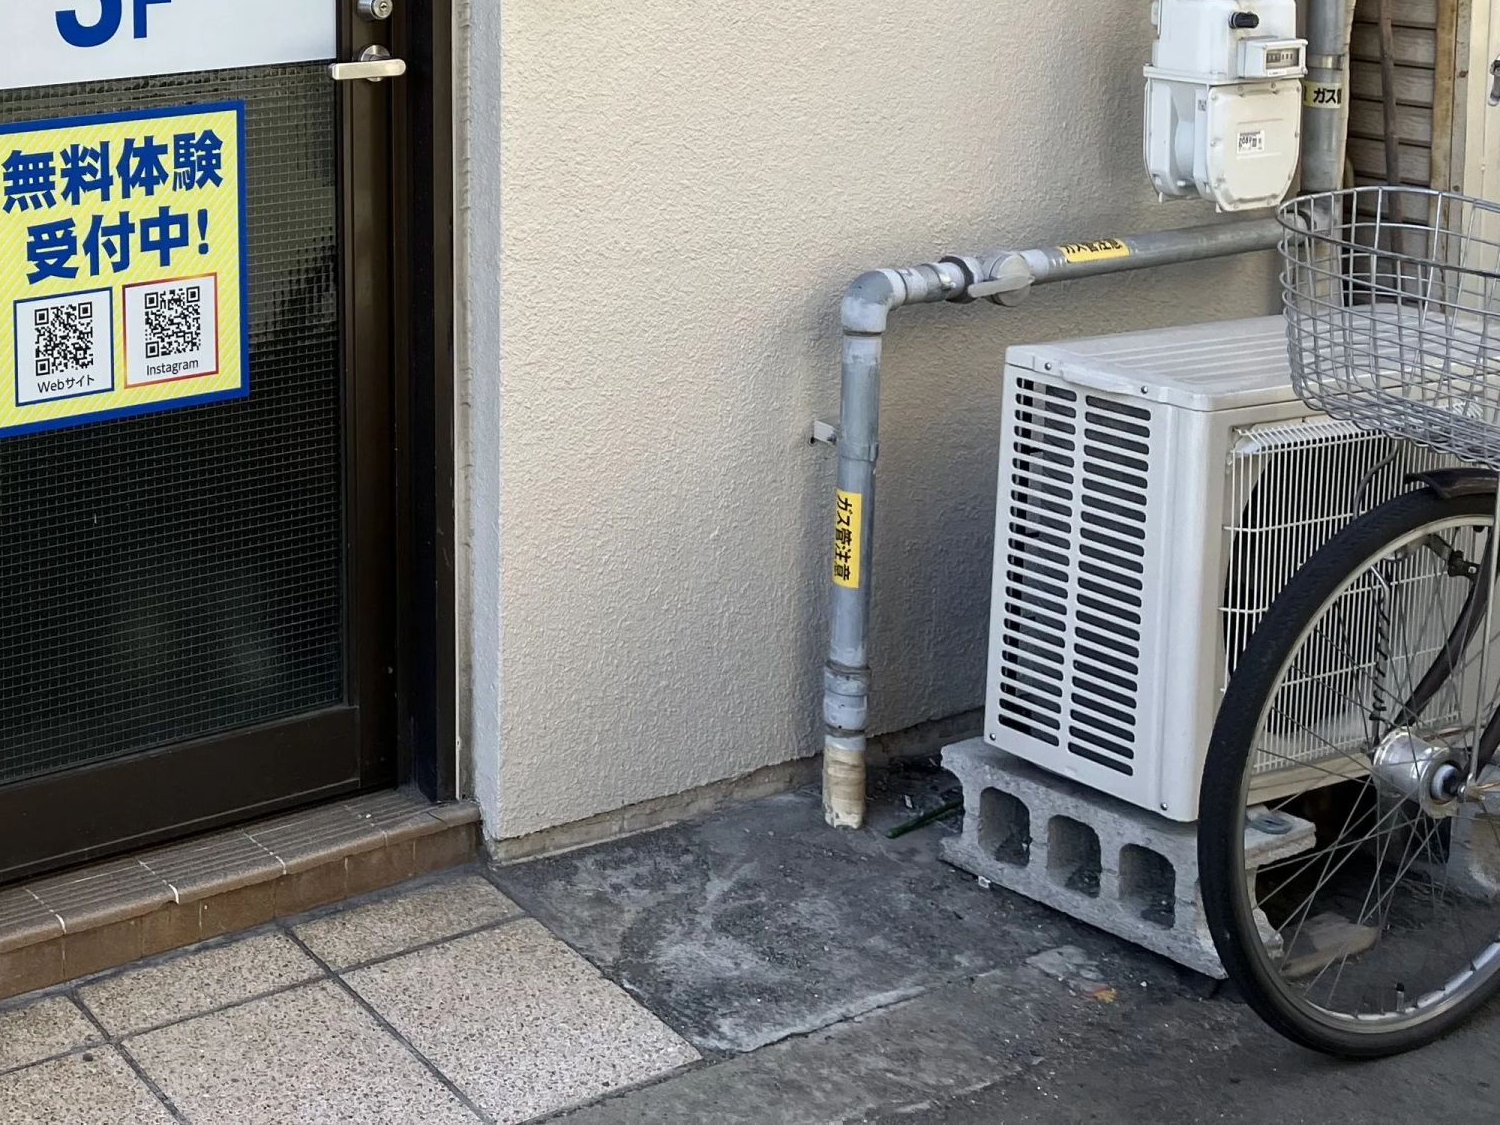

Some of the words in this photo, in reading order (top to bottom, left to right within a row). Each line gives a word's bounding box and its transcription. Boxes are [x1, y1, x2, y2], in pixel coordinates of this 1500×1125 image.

[1, 129, 224, 214] 無料体験
[26, 206, 210, 285] 受付中!
[37, 374, 94, 393] Webサイト
[146, 358, 199, 376] Instagram
[834, 495, 853, 581] ガス管注意
